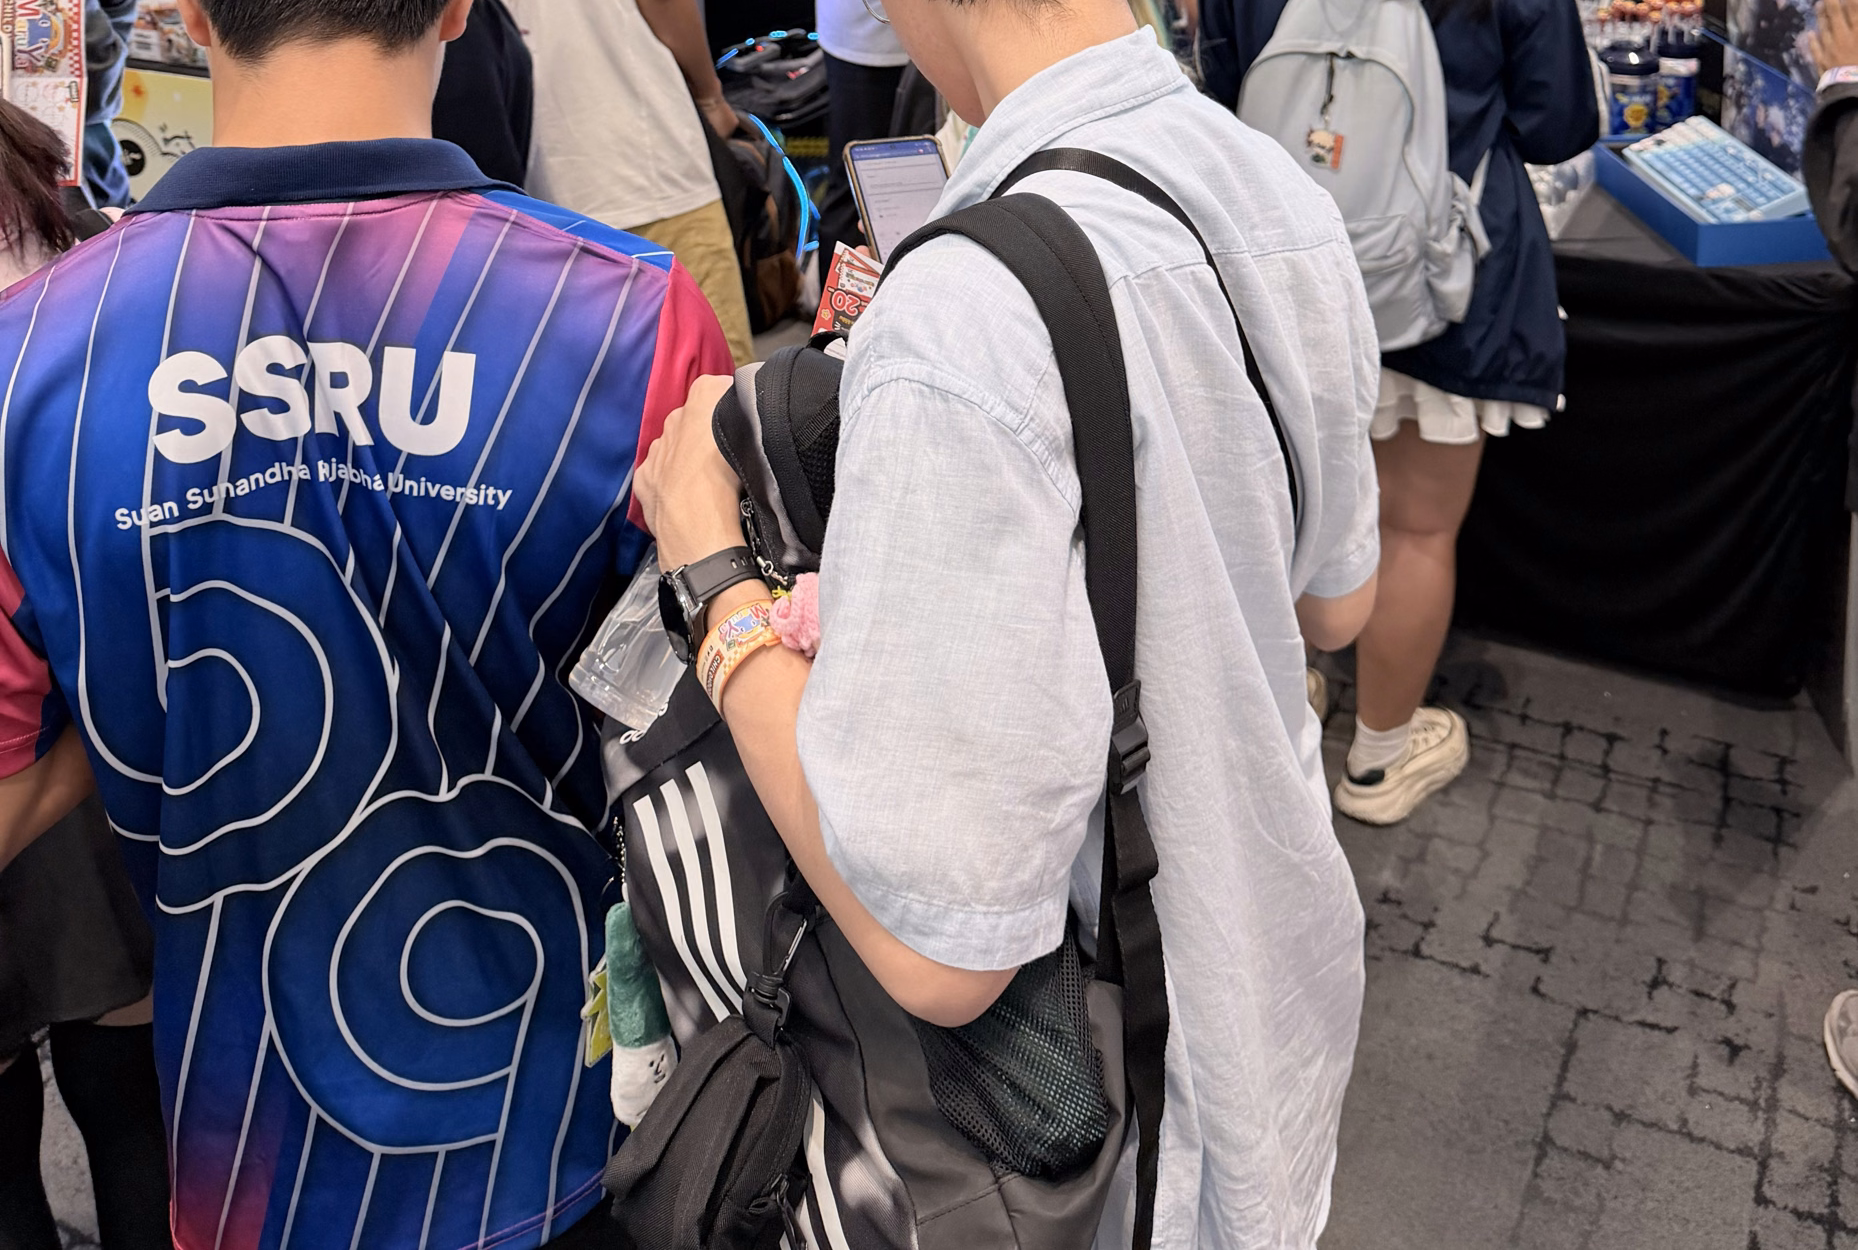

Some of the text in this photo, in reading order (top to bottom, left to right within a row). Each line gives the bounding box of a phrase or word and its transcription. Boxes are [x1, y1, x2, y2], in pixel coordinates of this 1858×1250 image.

[148, 335, 476, 464] SSRU
[115, 501, 179, 530] Suan
[186, 462, 311, 510] Sunandha
[387, 472, 512, 510] University
